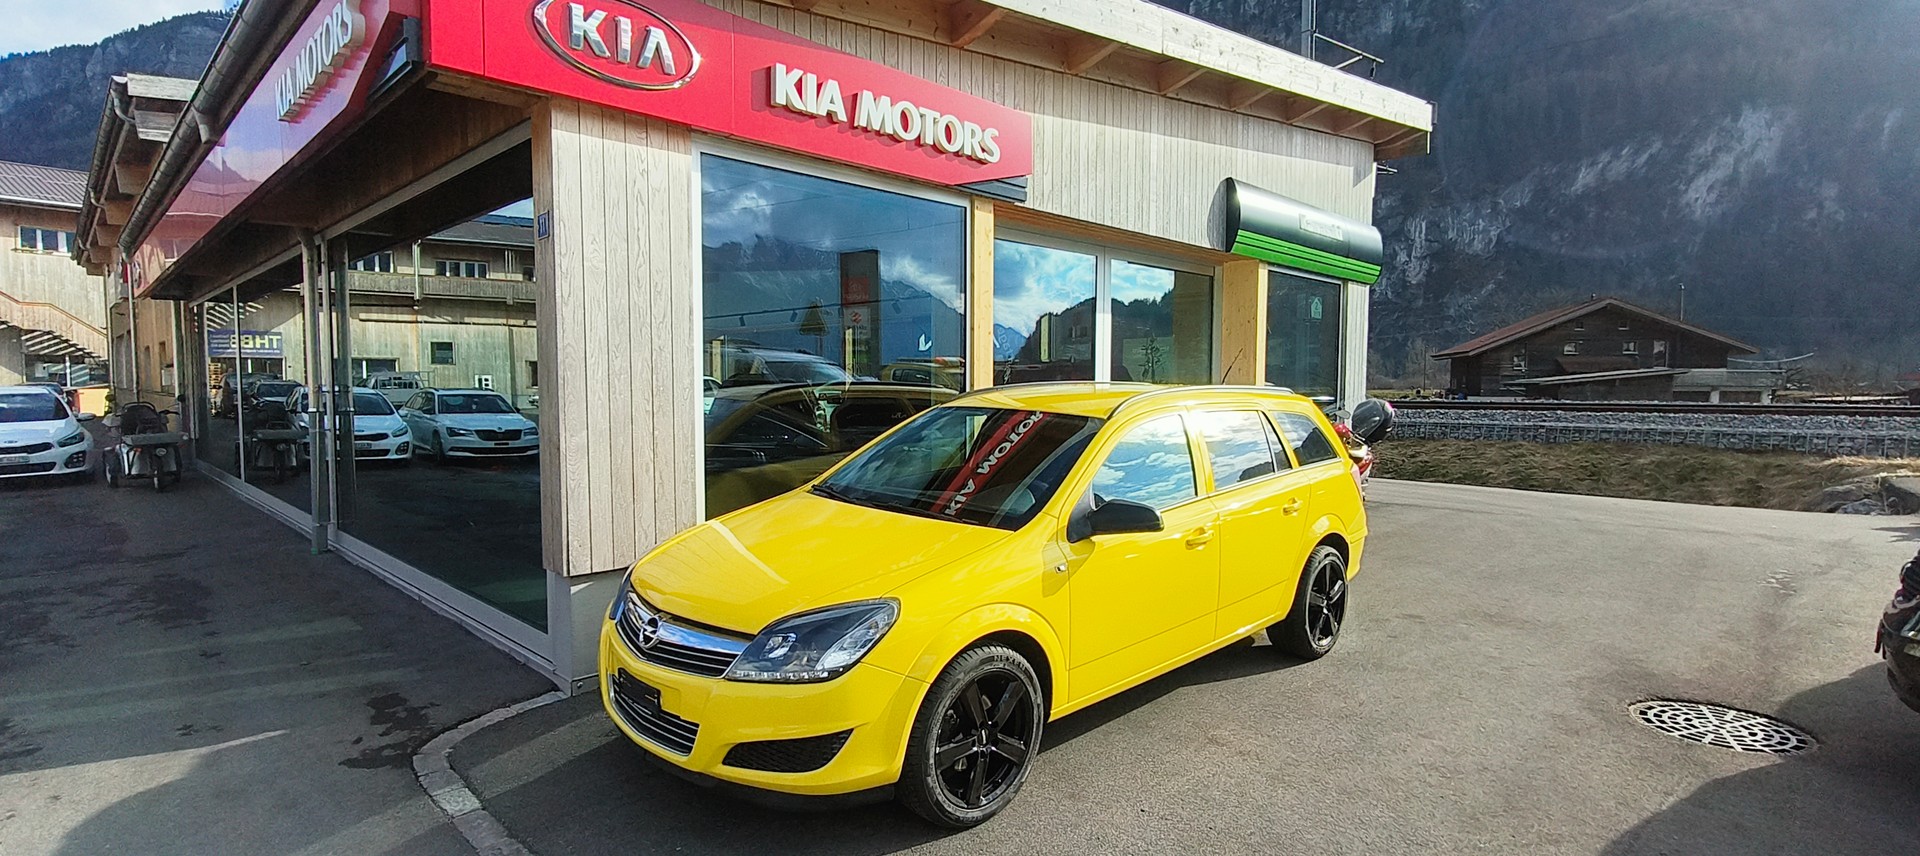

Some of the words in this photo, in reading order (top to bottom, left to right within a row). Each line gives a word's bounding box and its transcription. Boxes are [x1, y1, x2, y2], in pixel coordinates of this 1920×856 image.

[275, 67, 295, 121] KIA
[295, 0, 354, 98] MOTORS
[567, 2, 676, 76] KIA
[771, 62, 848, 123] KIA
[854, 89, 1001, 164] MOTORS
